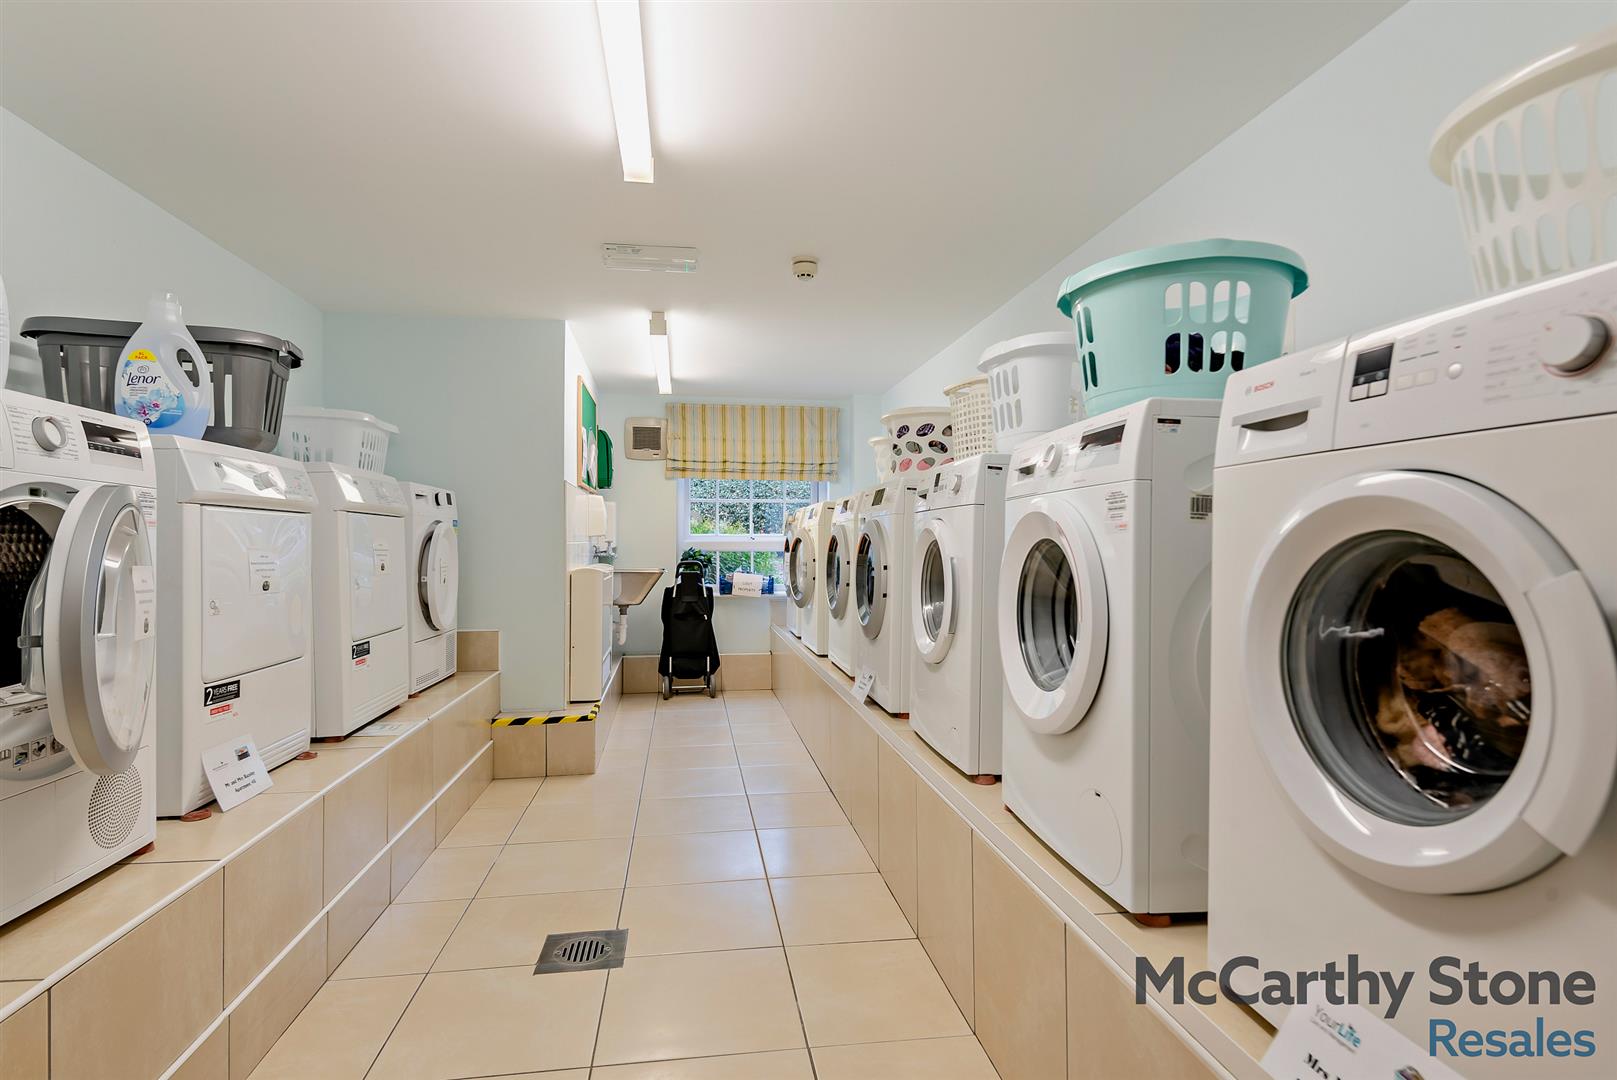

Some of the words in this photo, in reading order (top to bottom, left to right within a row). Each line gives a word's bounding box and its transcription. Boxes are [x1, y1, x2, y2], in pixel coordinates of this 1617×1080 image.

[126, 372, 161, 386] Lenor
[206, 688, 213, 705] 2
[213, 685, 227, 696] YEARS
[227, 683, 239, 692] FREE
[1303, 1052, 1329, 1080] Mrs
